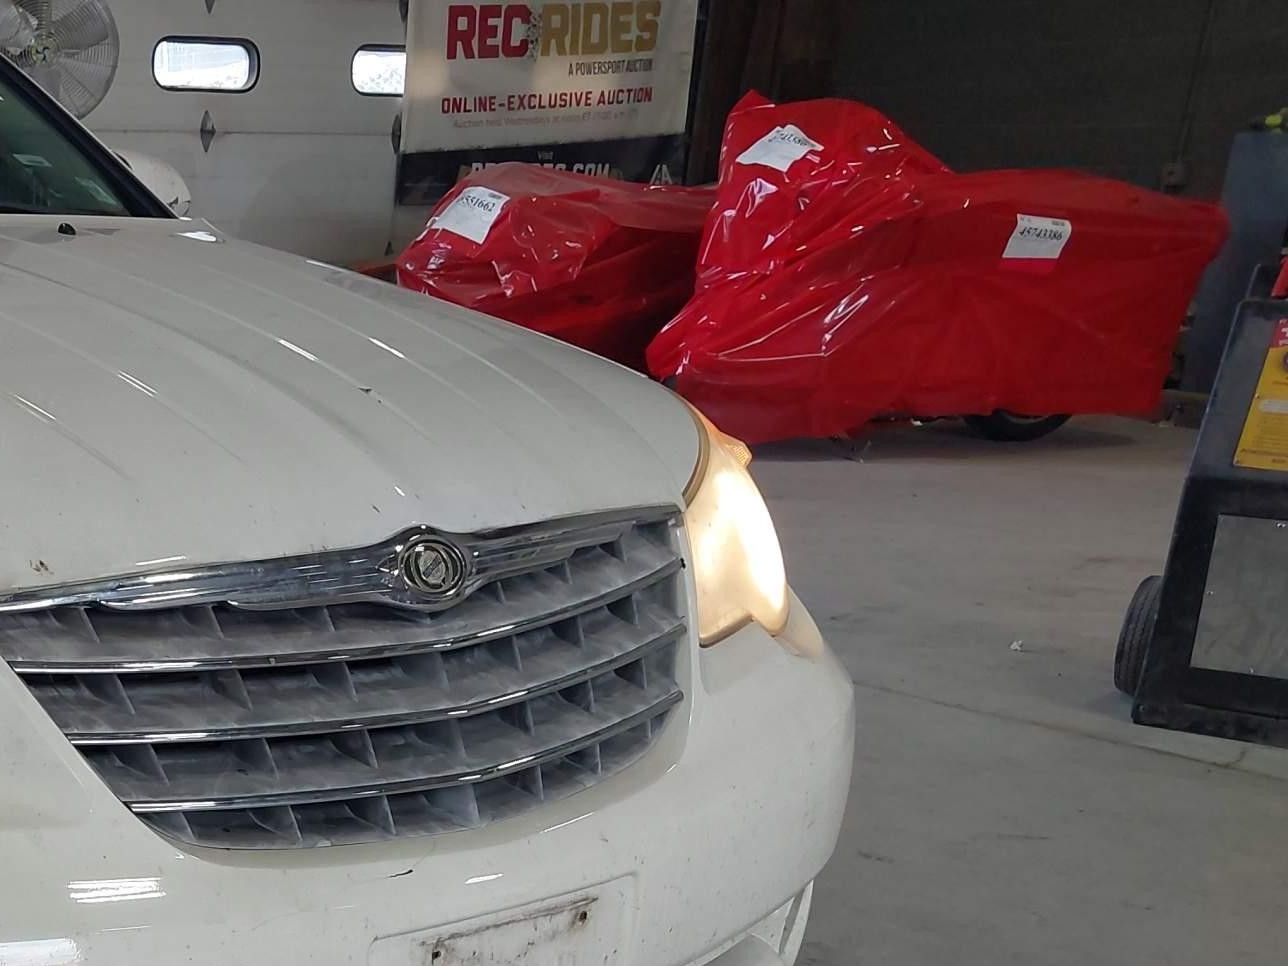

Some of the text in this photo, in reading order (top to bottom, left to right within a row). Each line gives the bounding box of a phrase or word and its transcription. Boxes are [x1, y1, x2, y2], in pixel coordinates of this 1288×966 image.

[575, 60, 625, 76] POWERSPORT
[625, 58, 653, 73] AUCTION
[441, 90, 592, 115] ONLINE-EXCLUSIVE
[597, 87, 653, 106] AUCTION
